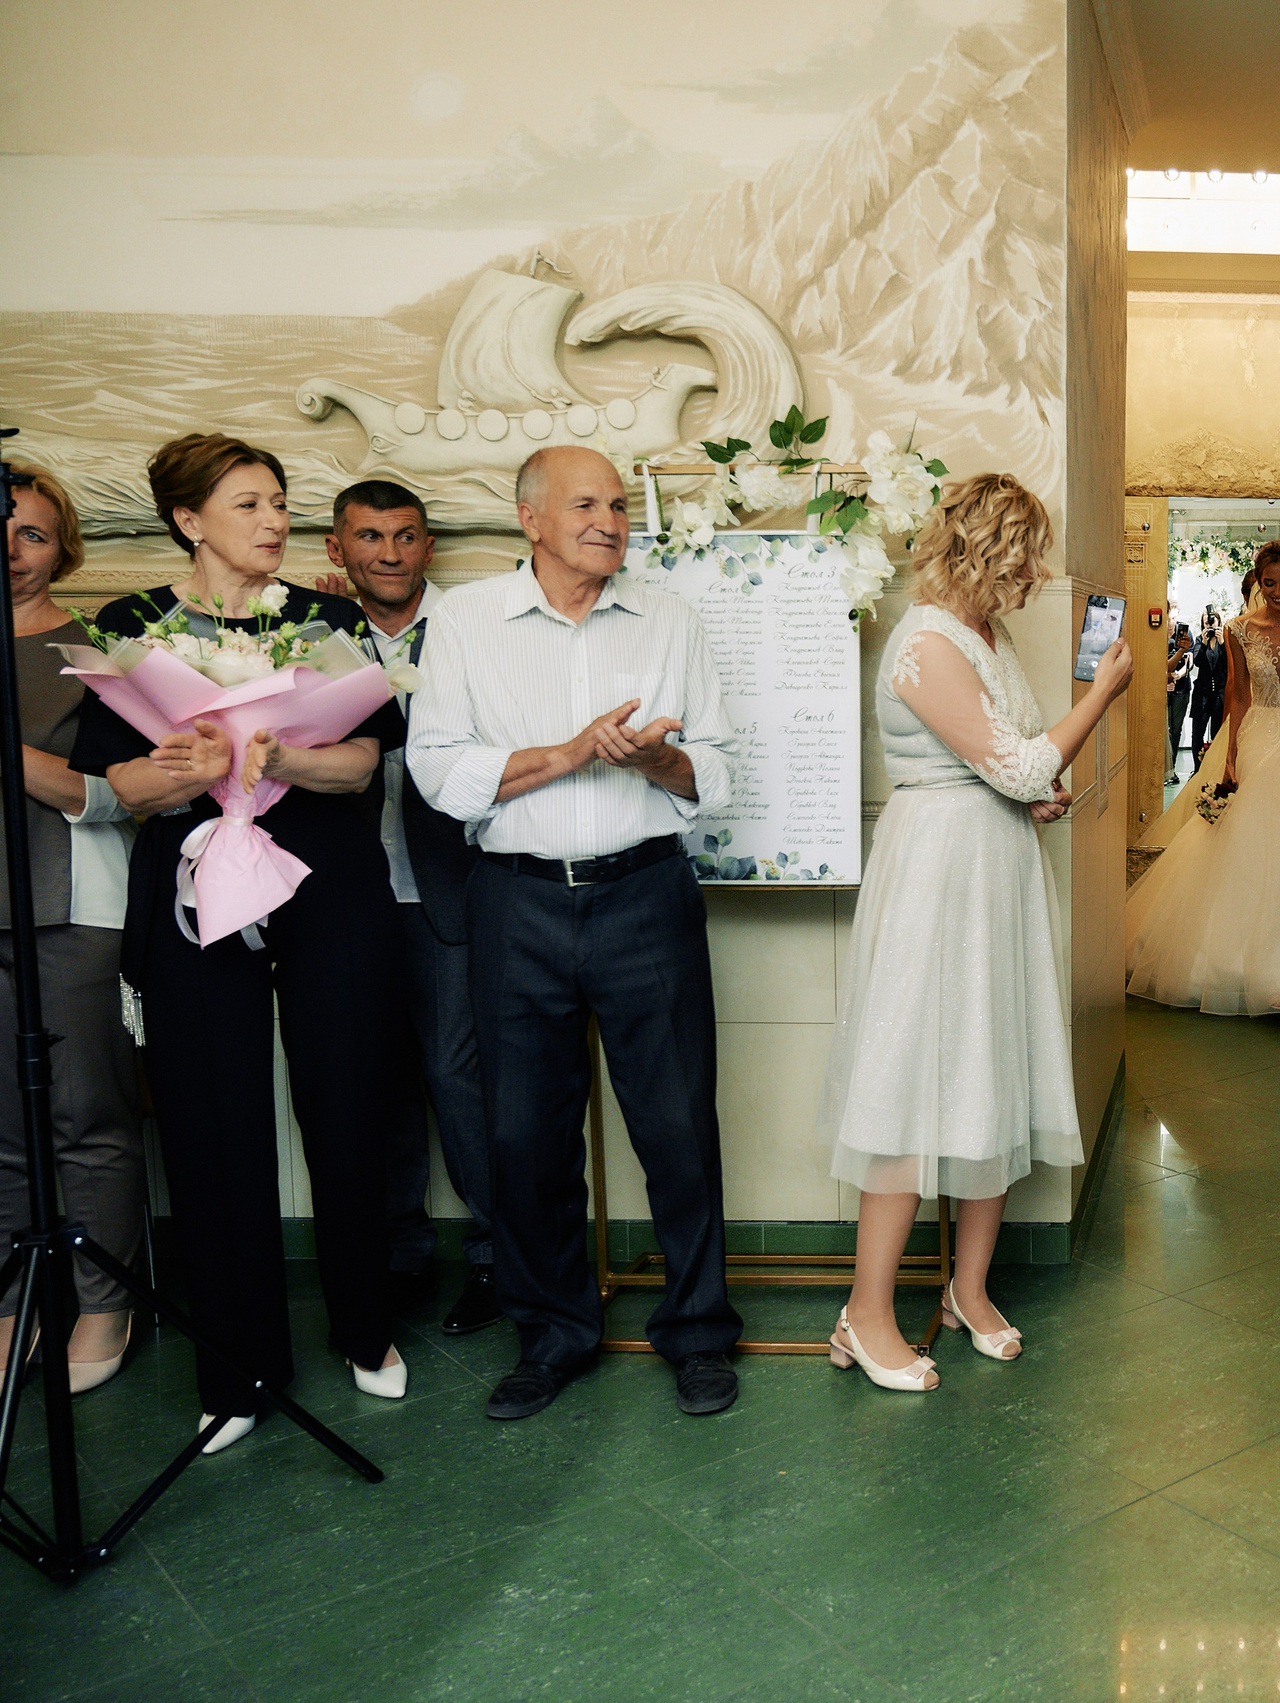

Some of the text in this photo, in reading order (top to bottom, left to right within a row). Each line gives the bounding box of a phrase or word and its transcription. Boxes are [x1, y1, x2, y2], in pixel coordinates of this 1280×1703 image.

[784, 563, 837, 578] Стол 3
[790, 707, 836, 723] Стол 6
[750, 722, 759, 735] 5
